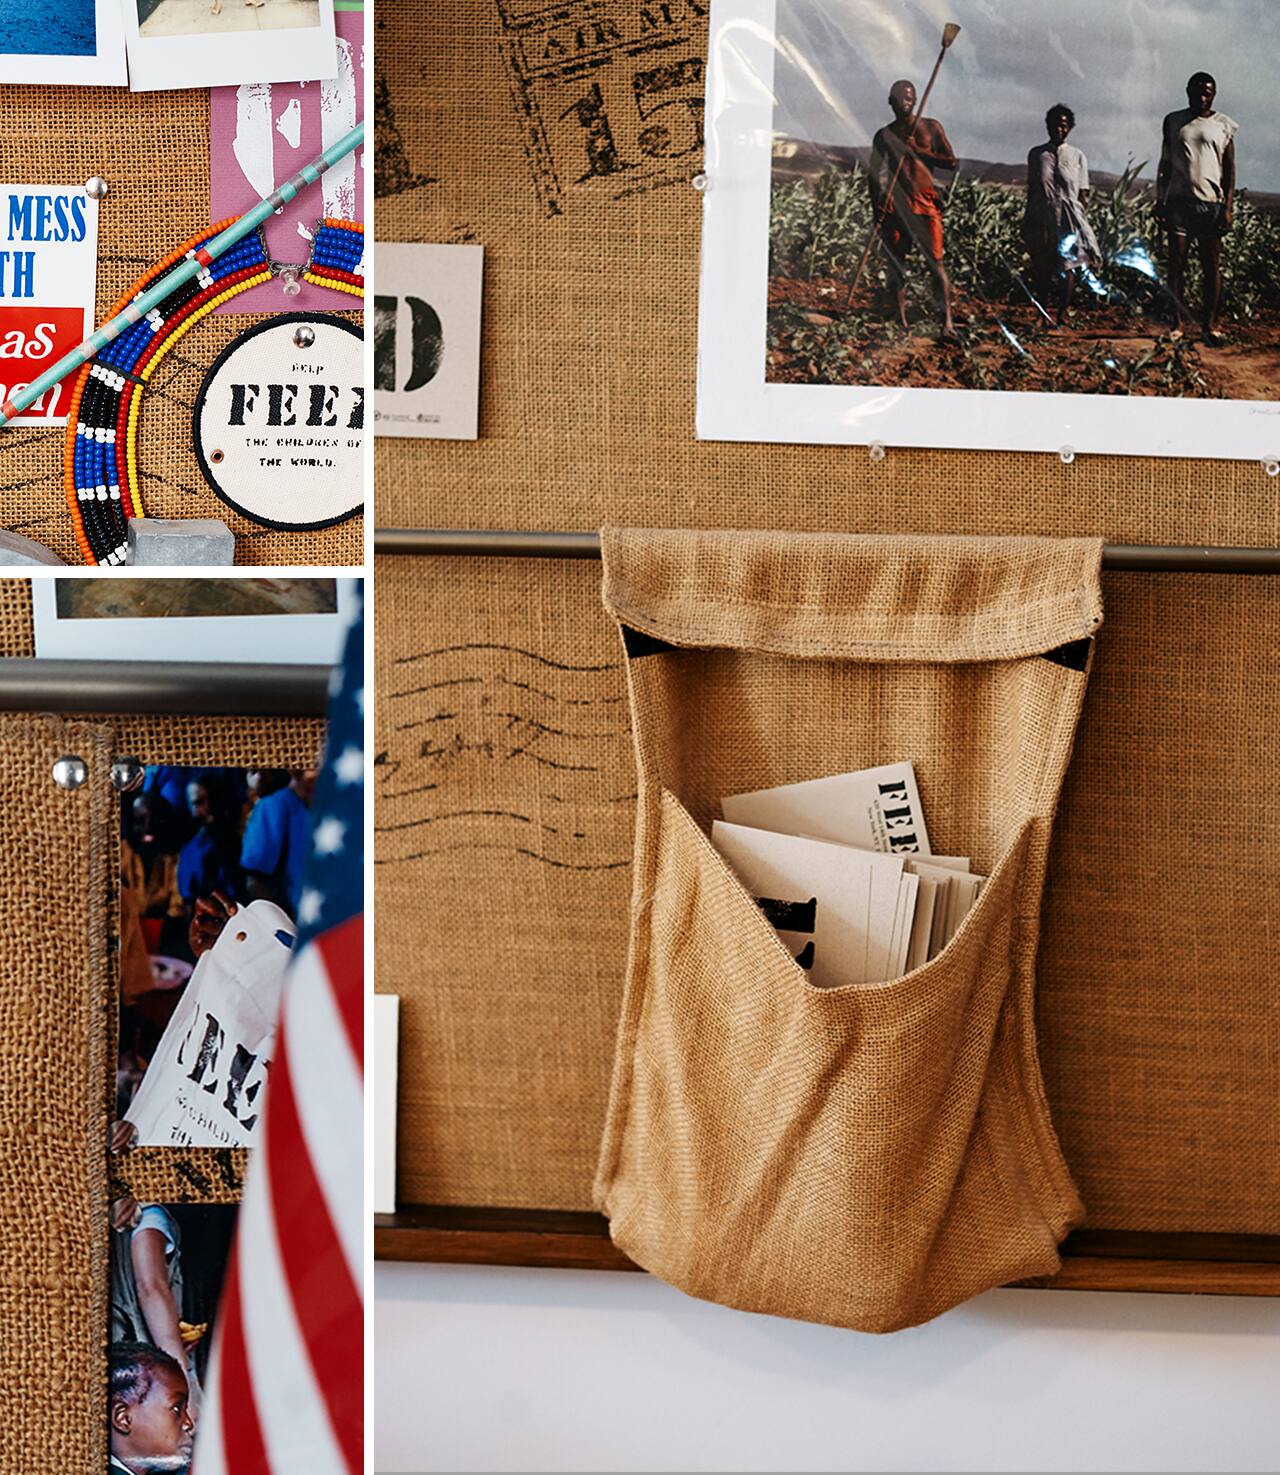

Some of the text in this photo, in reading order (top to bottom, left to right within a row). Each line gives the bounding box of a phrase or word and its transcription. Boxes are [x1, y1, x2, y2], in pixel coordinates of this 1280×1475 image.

[7, 194, 87, 242] MESS
[292, 363, 324, 375] HELP
[246, 438, 268, 447] THE
[276, 438, 339, 448] CHILDREN
[260, 458, 337, 467] THE WORLD.
